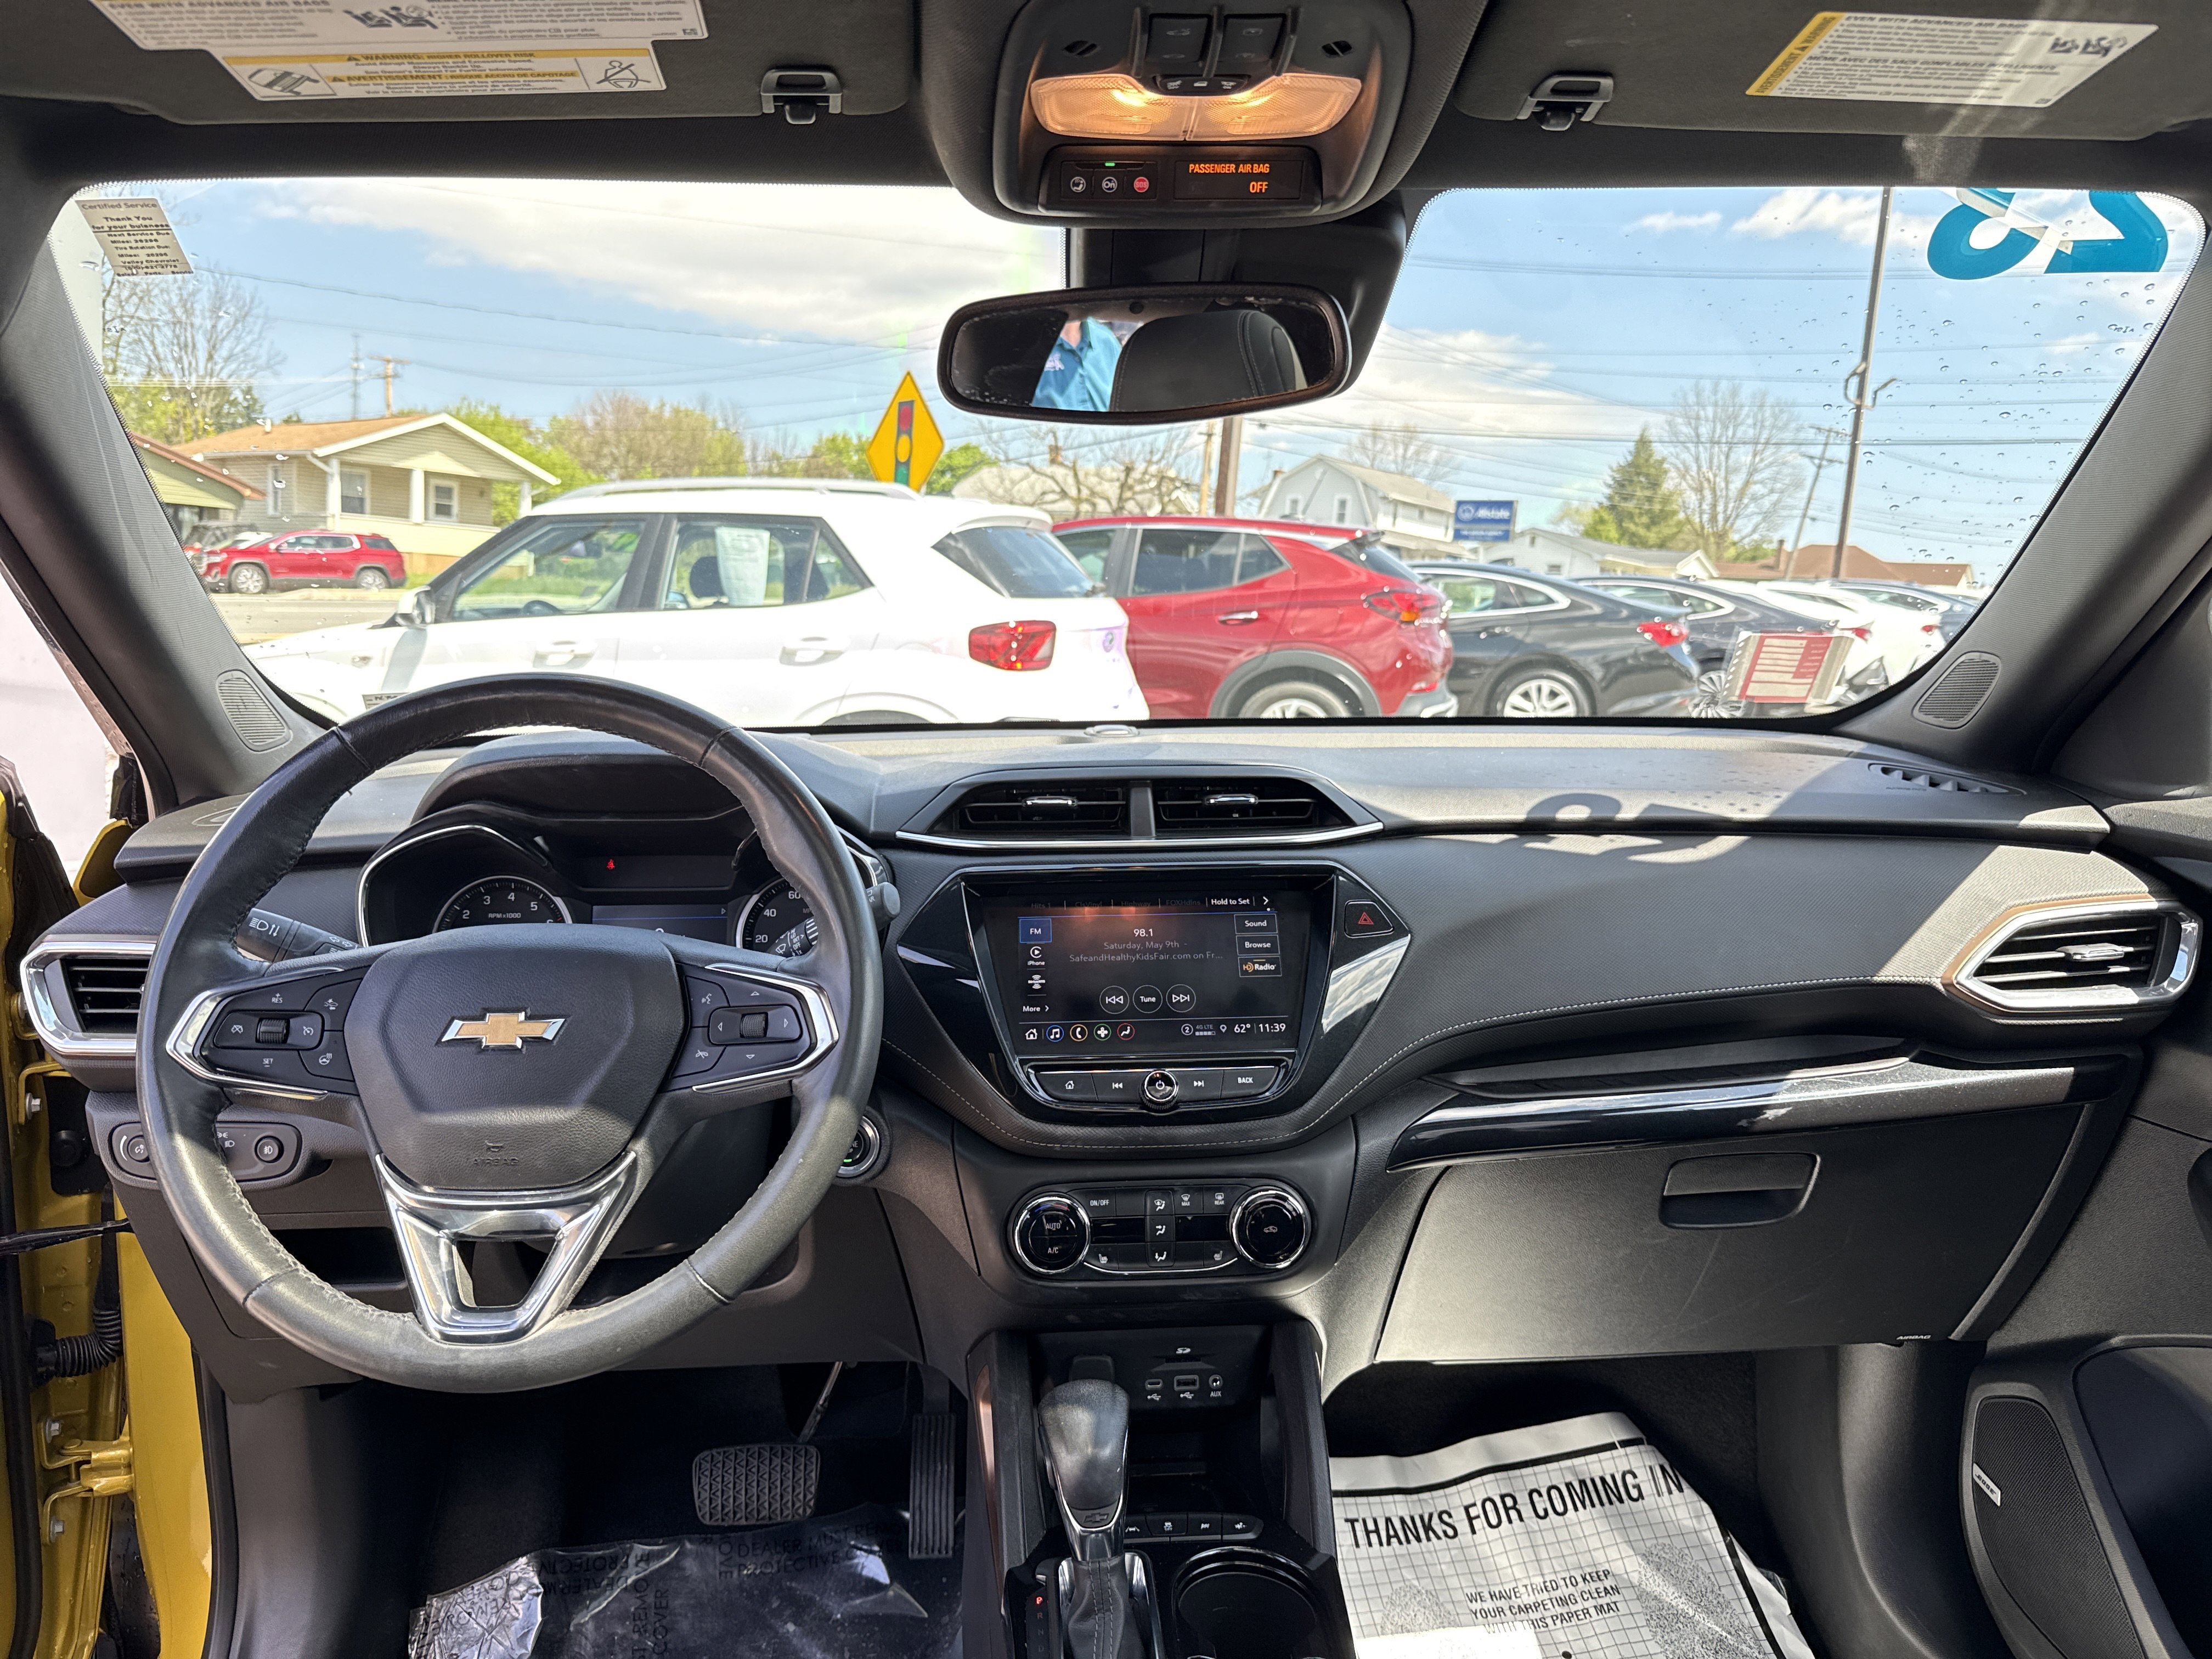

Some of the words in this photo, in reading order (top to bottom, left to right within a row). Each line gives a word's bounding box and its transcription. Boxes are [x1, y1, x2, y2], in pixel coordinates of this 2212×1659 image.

[1189, 163, 1236, 173] PASSENGER
[1238, 163, 1252, 173] AIR
[1253, 163, 1270, 173] BAG
[1249, 182, 1268, 193] OFF
[483, 895, 491, 905] 3
[507, 892, 515, 901] 4
[788, 891, 801, 899] 60
[531, 901, 538, 911] 5
[462, 910, 470, 919] 2
[764, 909, 777, 917] 40
[1133, 928, 1153, 937] 98.1
[755, 934, 768, 943] 20
[793, 942, 801, 950] OFF
[1104, 942, 1143, 951] Saturday,
[1146, 941, 1163, 950] May
[1070, 952, 1191, 963] SafeandHealthyKidsFair.com
[1259, 1023, 1286, 1032] 11:39
[1344, 1511, 1459, 1549] THANKS
[1463, 1493, 1525, 1536] FOR
[1528, 1468, 1644, 1520] COMING
[1650, 1464, 1685, 1498] IN
[1466, 1592, 1487, 1604] WE
[1489, 1587, 1521, 1601] HAVE
[1522, 1579, 1559, 1598] TRIED
[1561, 1575, 1579, 1589] TO
[1581, 1569, 1611, 1585] KEEP
[1471, 1606, 1506, 1620] YOUR
[1509, 1593, 1578, 1616] CARPETING
[1581, 1584, 1621, 1602] CLEAN
[1550, 1608, 1592, 1626] PAPER
[1594, 1600, 1621, 1616] MAT
